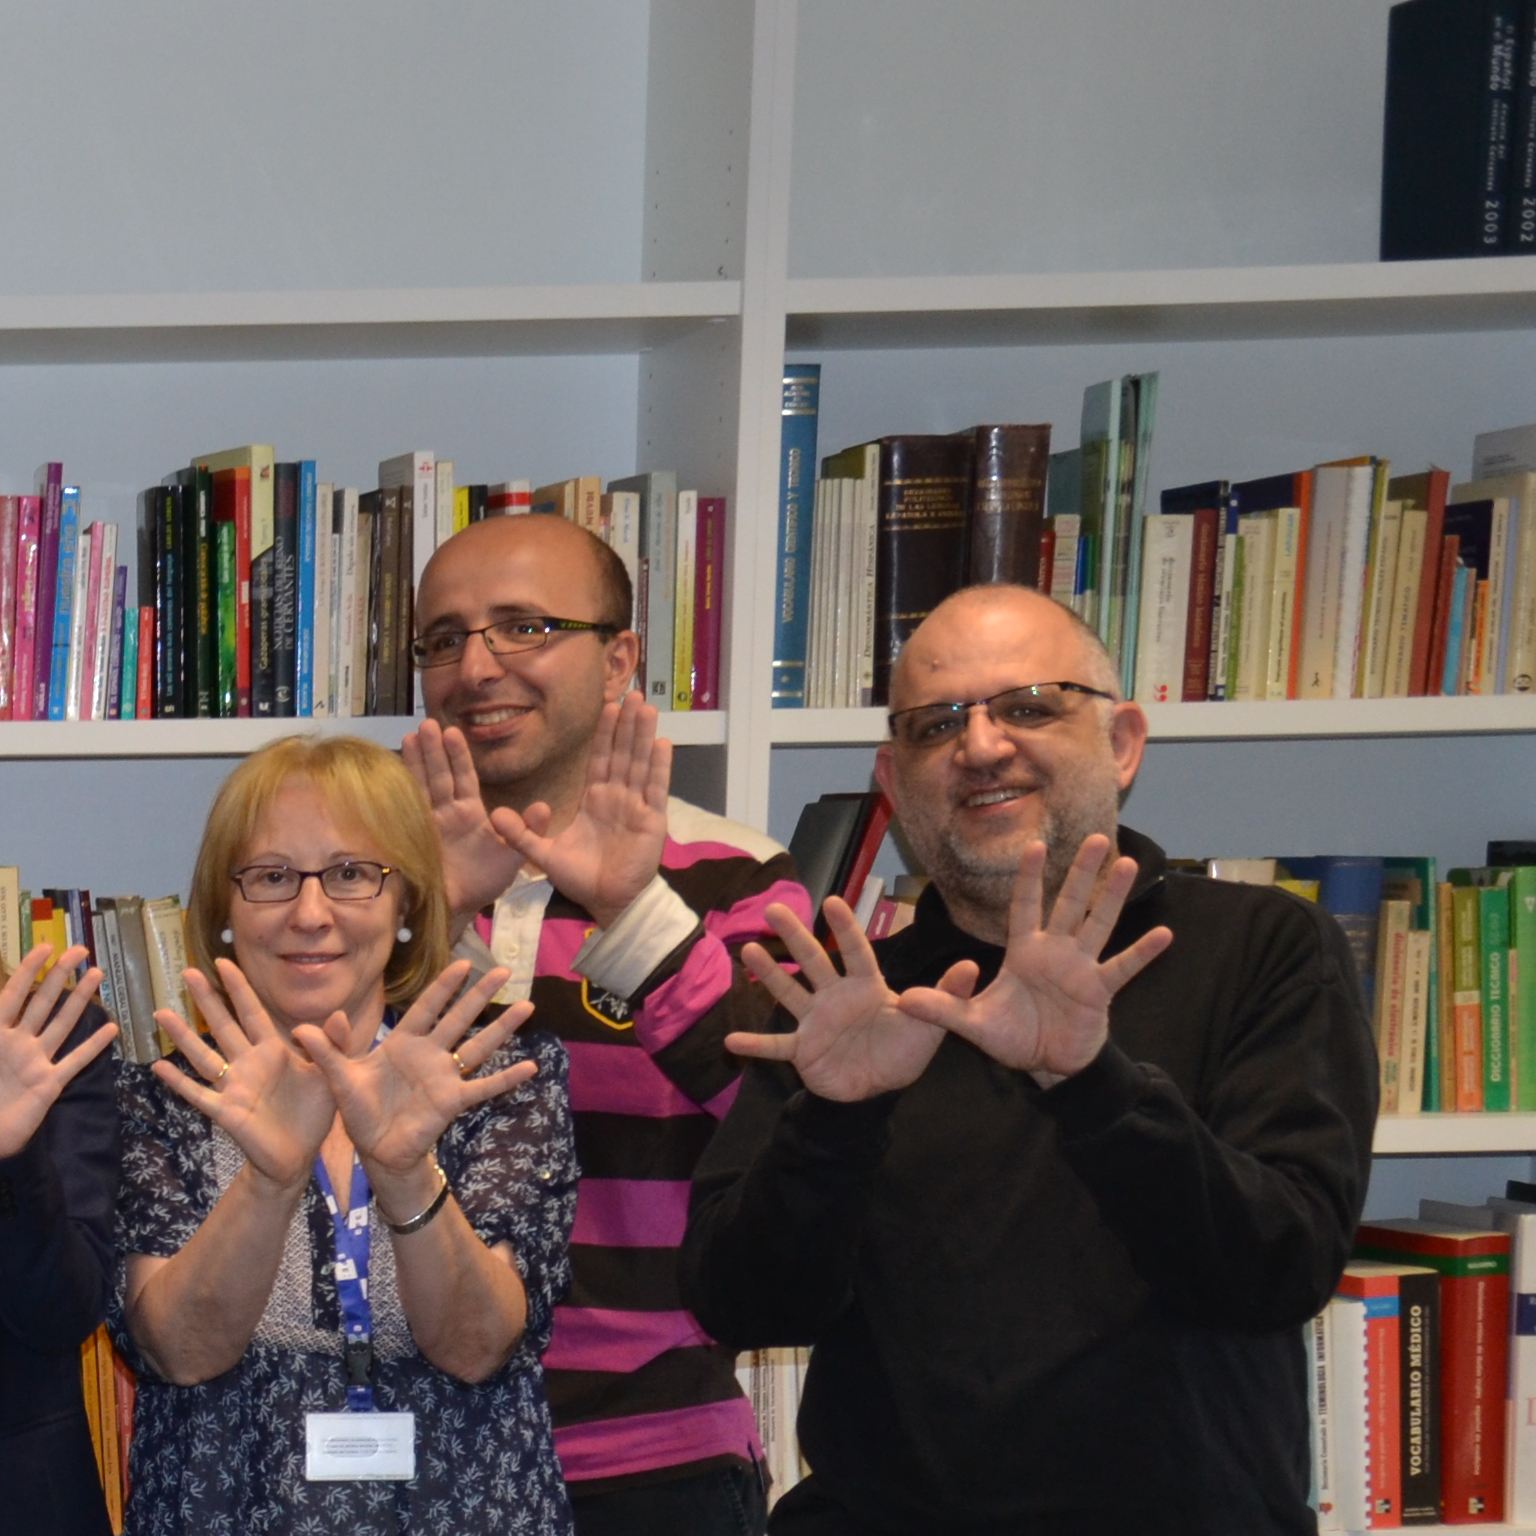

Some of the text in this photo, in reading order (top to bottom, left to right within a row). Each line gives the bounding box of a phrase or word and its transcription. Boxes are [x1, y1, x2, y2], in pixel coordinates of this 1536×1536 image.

[1484, 199, 1500, 245] 2003
[1519, 195, 1536, 243] 2002
[273, 536, 285, 650] NOTICIAS DEL REINO
[283, 554, 295, 634] CERVANTES
[781, 557, 797, 624] VOCABULARIO
[1489, 951, 1502, 1082] DICCIONARIO TECNICO
[1407, 1304, 1423, 1367] MÉDICO
[1409, 1370, 1423, 1476] VOCABULARIO
